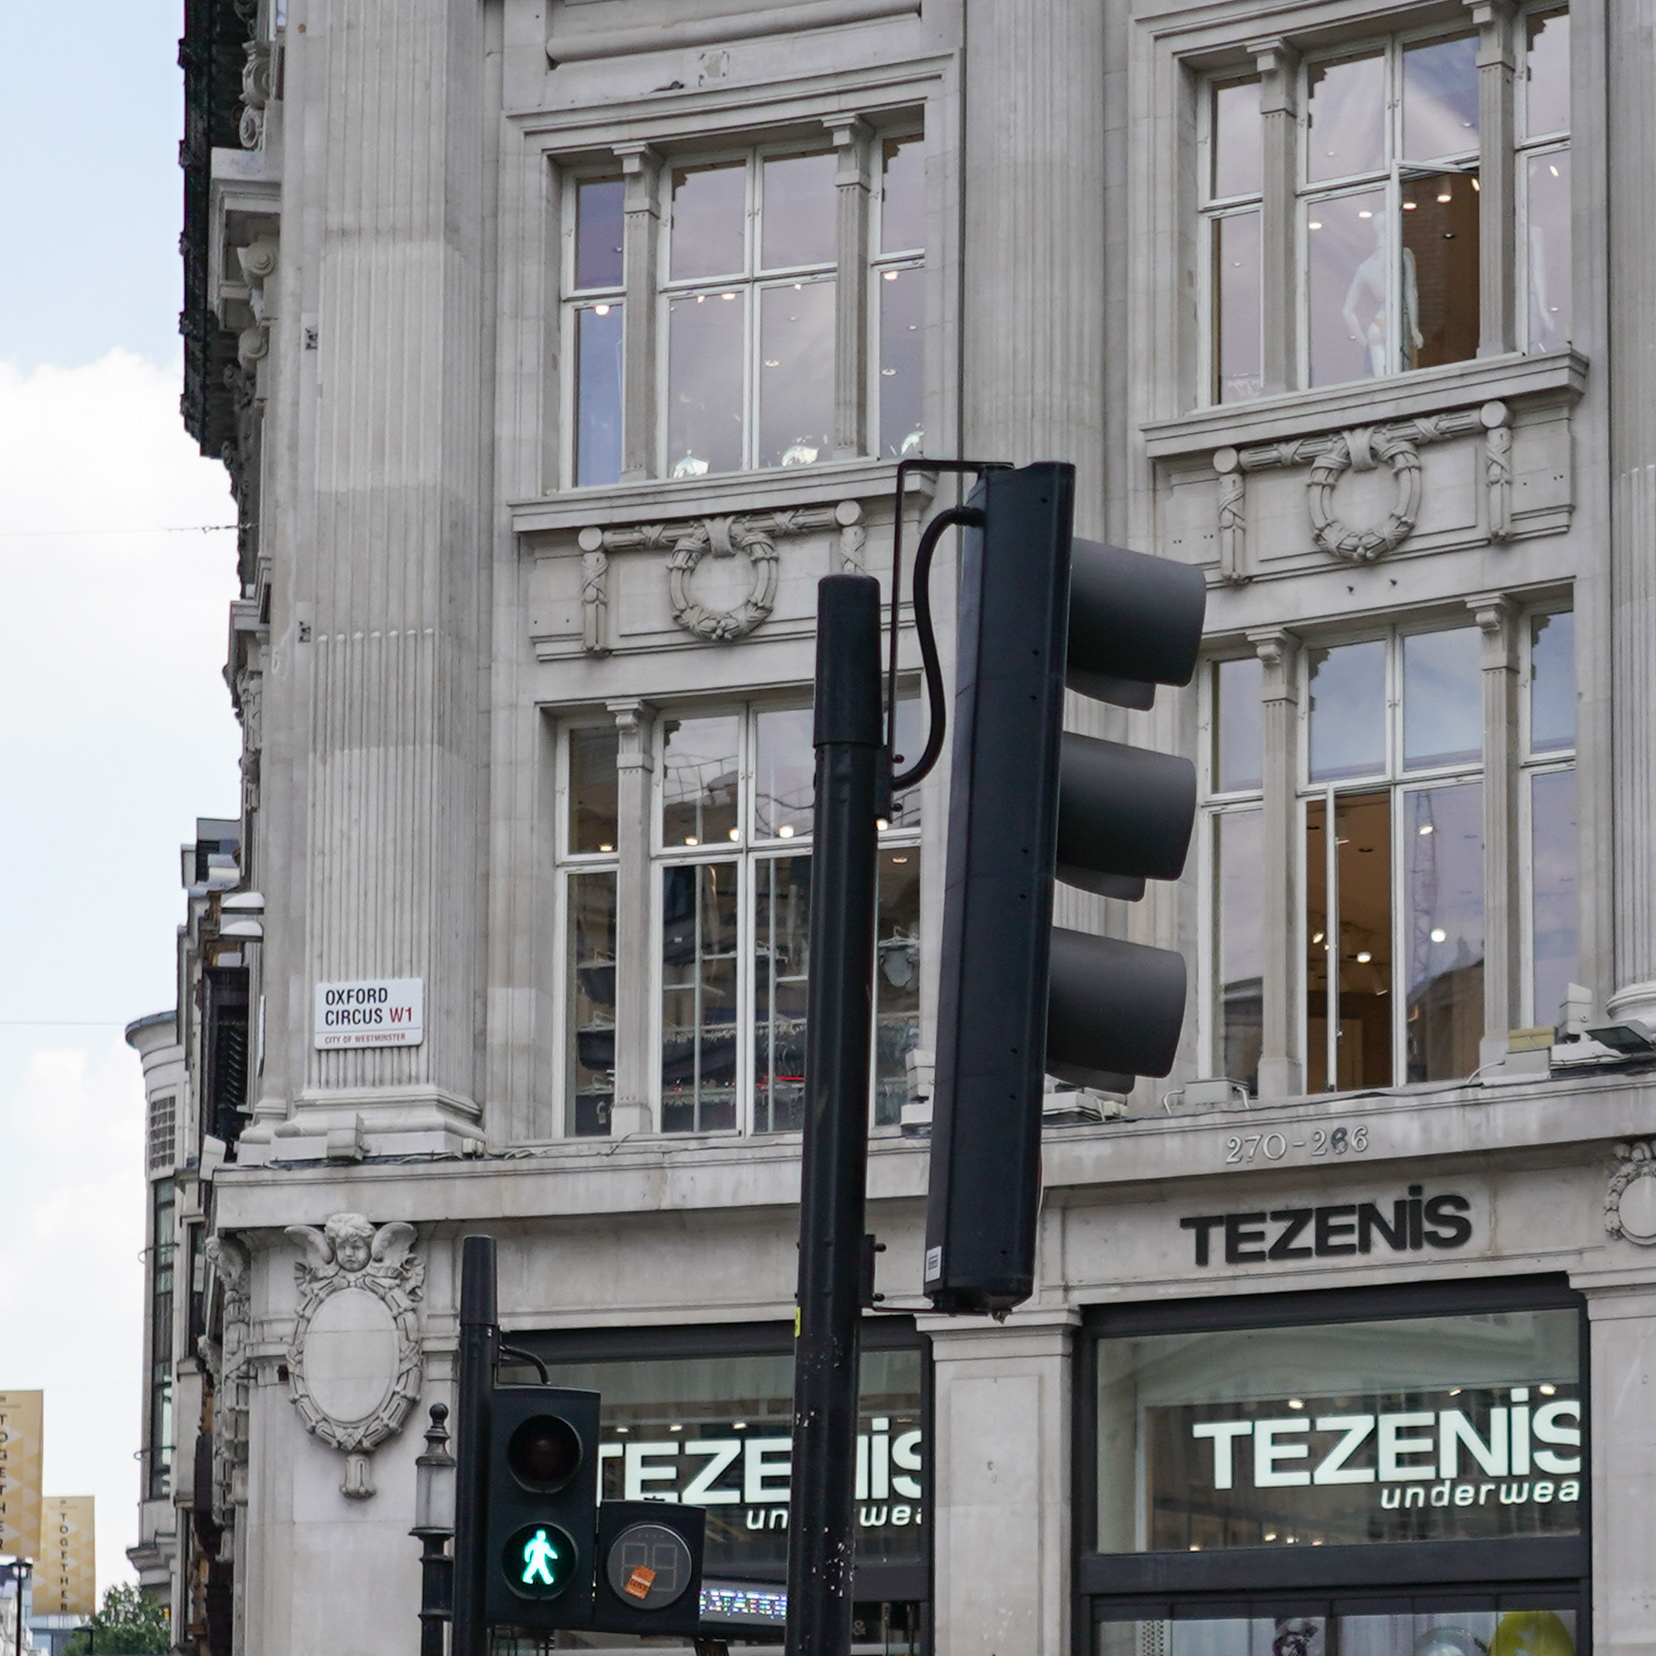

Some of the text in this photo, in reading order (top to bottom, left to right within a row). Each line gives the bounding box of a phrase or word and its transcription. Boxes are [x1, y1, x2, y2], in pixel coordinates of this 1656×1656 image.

[325, 987, 388, 1005] OXFORD
[325, 1006, 412, 1026] CIRCUS W1
[324, 1036, 342, 1044] CITY
[354, 1033, 406, 1043] WESTMINSTER
[59, 1513, 69, 1612] TOGETHER
